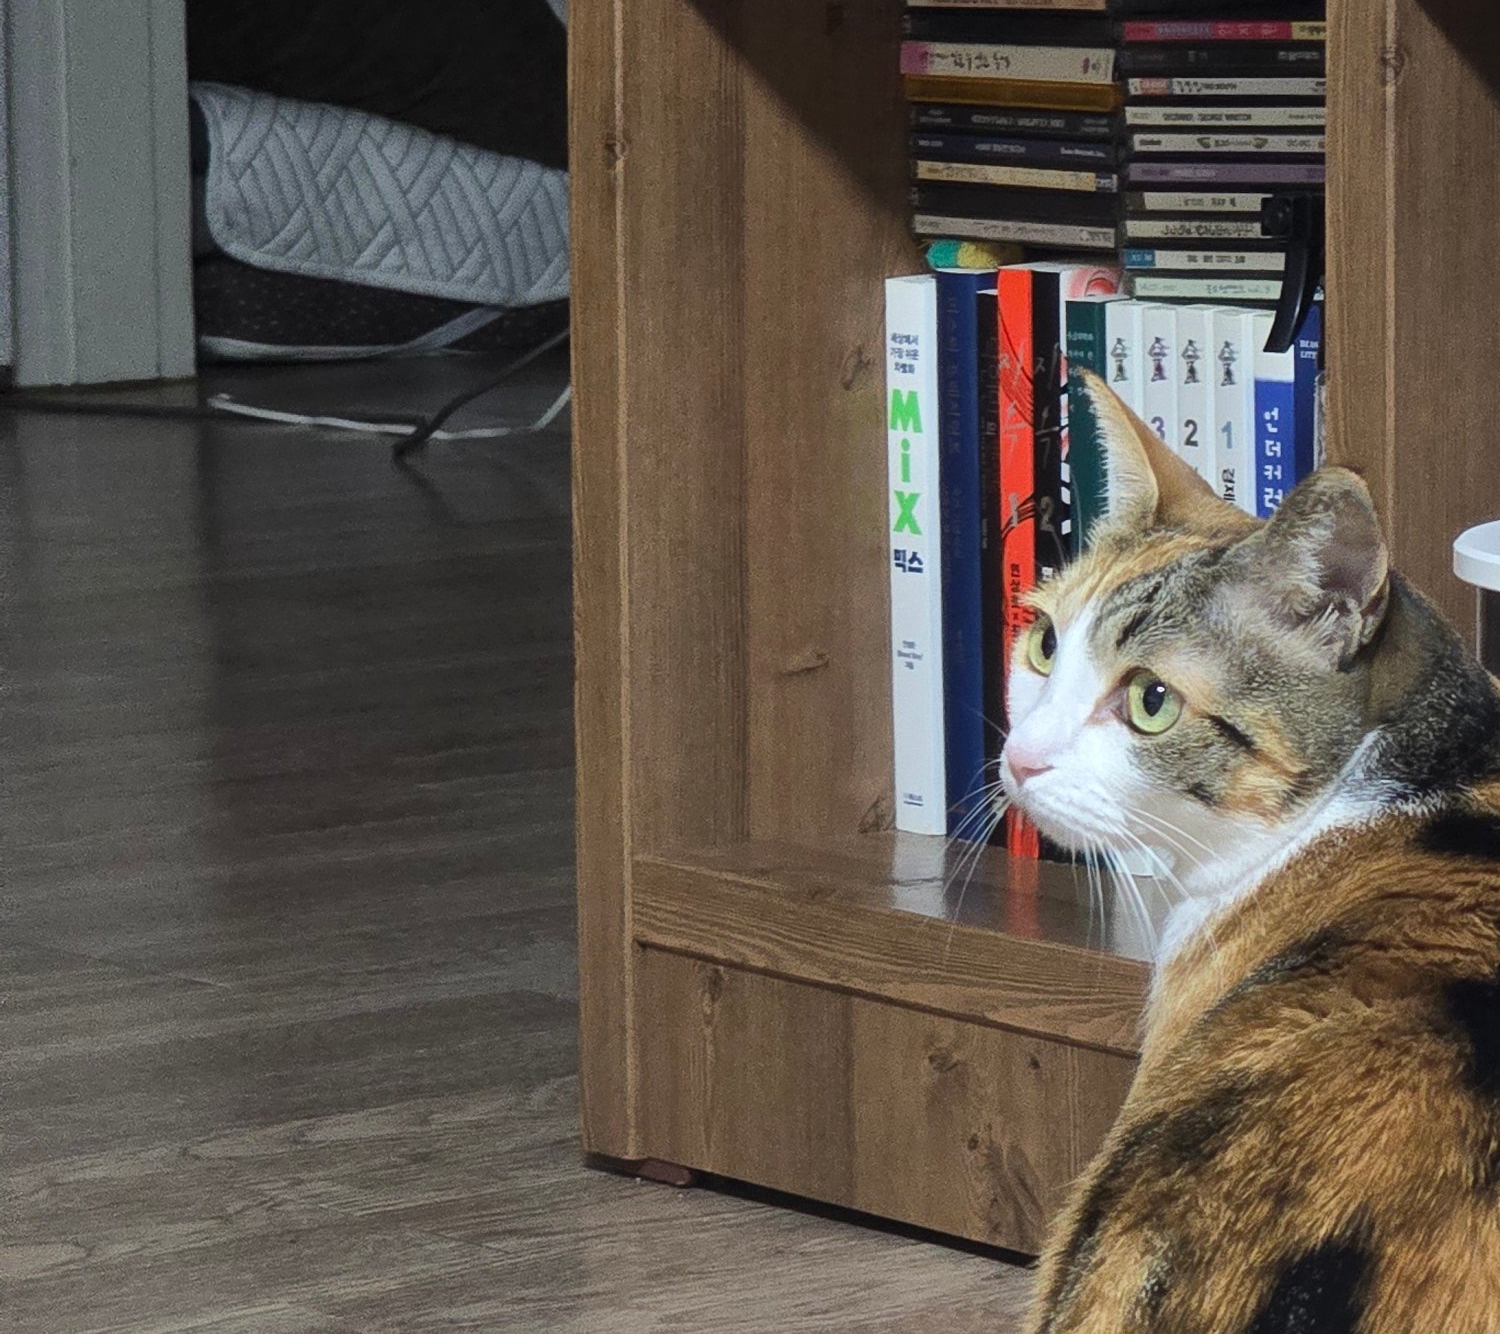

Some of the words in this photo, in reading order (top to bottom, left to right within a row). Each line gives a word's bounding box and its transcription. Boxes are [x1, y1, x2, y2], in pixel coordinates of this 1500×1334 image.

[1151, 416, 1166, 441] 3
[1184, 419, 1199, 447] 2
[1221, 421, 1233, 449] 1
[893, 549, 924, 574] 믹스
